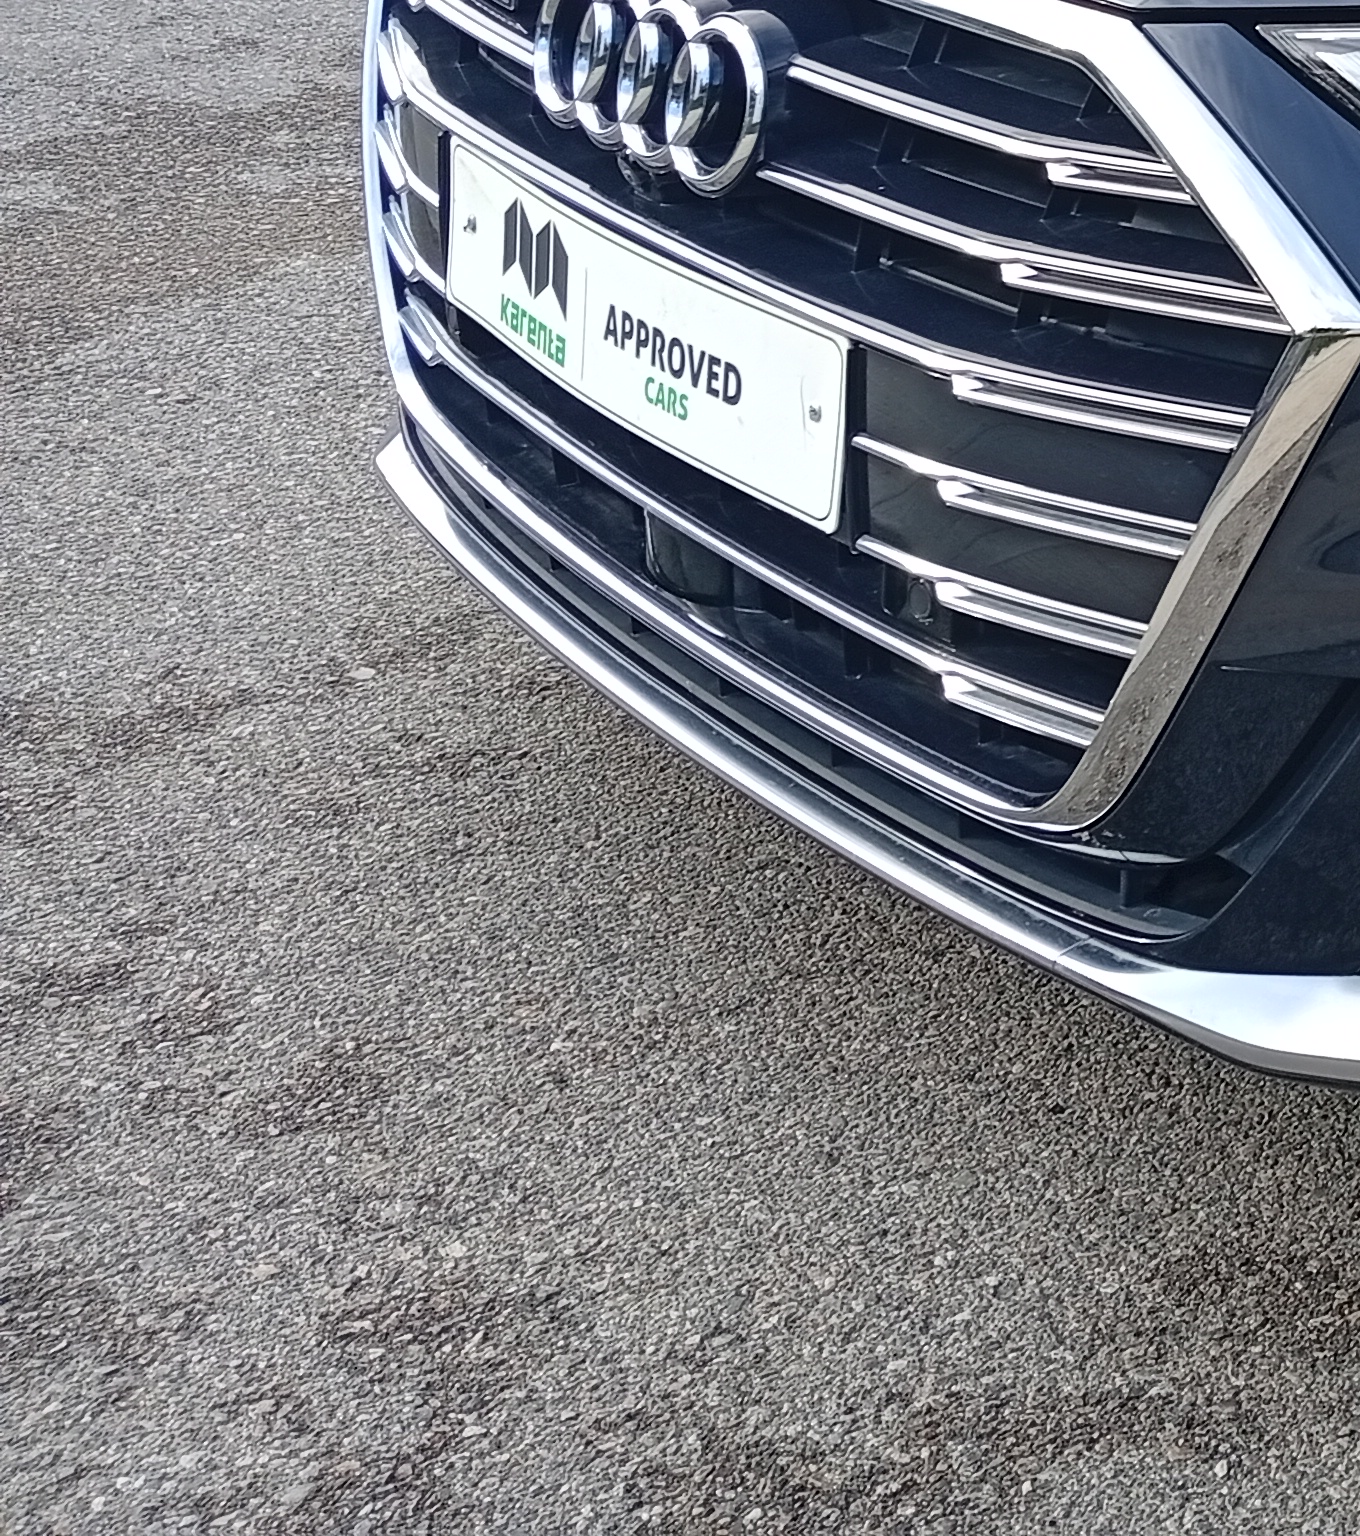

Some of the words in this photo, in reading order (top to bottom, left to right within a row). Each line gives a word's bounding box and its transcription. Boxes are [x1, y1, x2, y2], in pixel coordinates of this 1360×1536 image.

[500, 293, 566, 368] karenta
[603, 303, 742, 406] APPROVED
[644, 376, 689, 421] CARS
